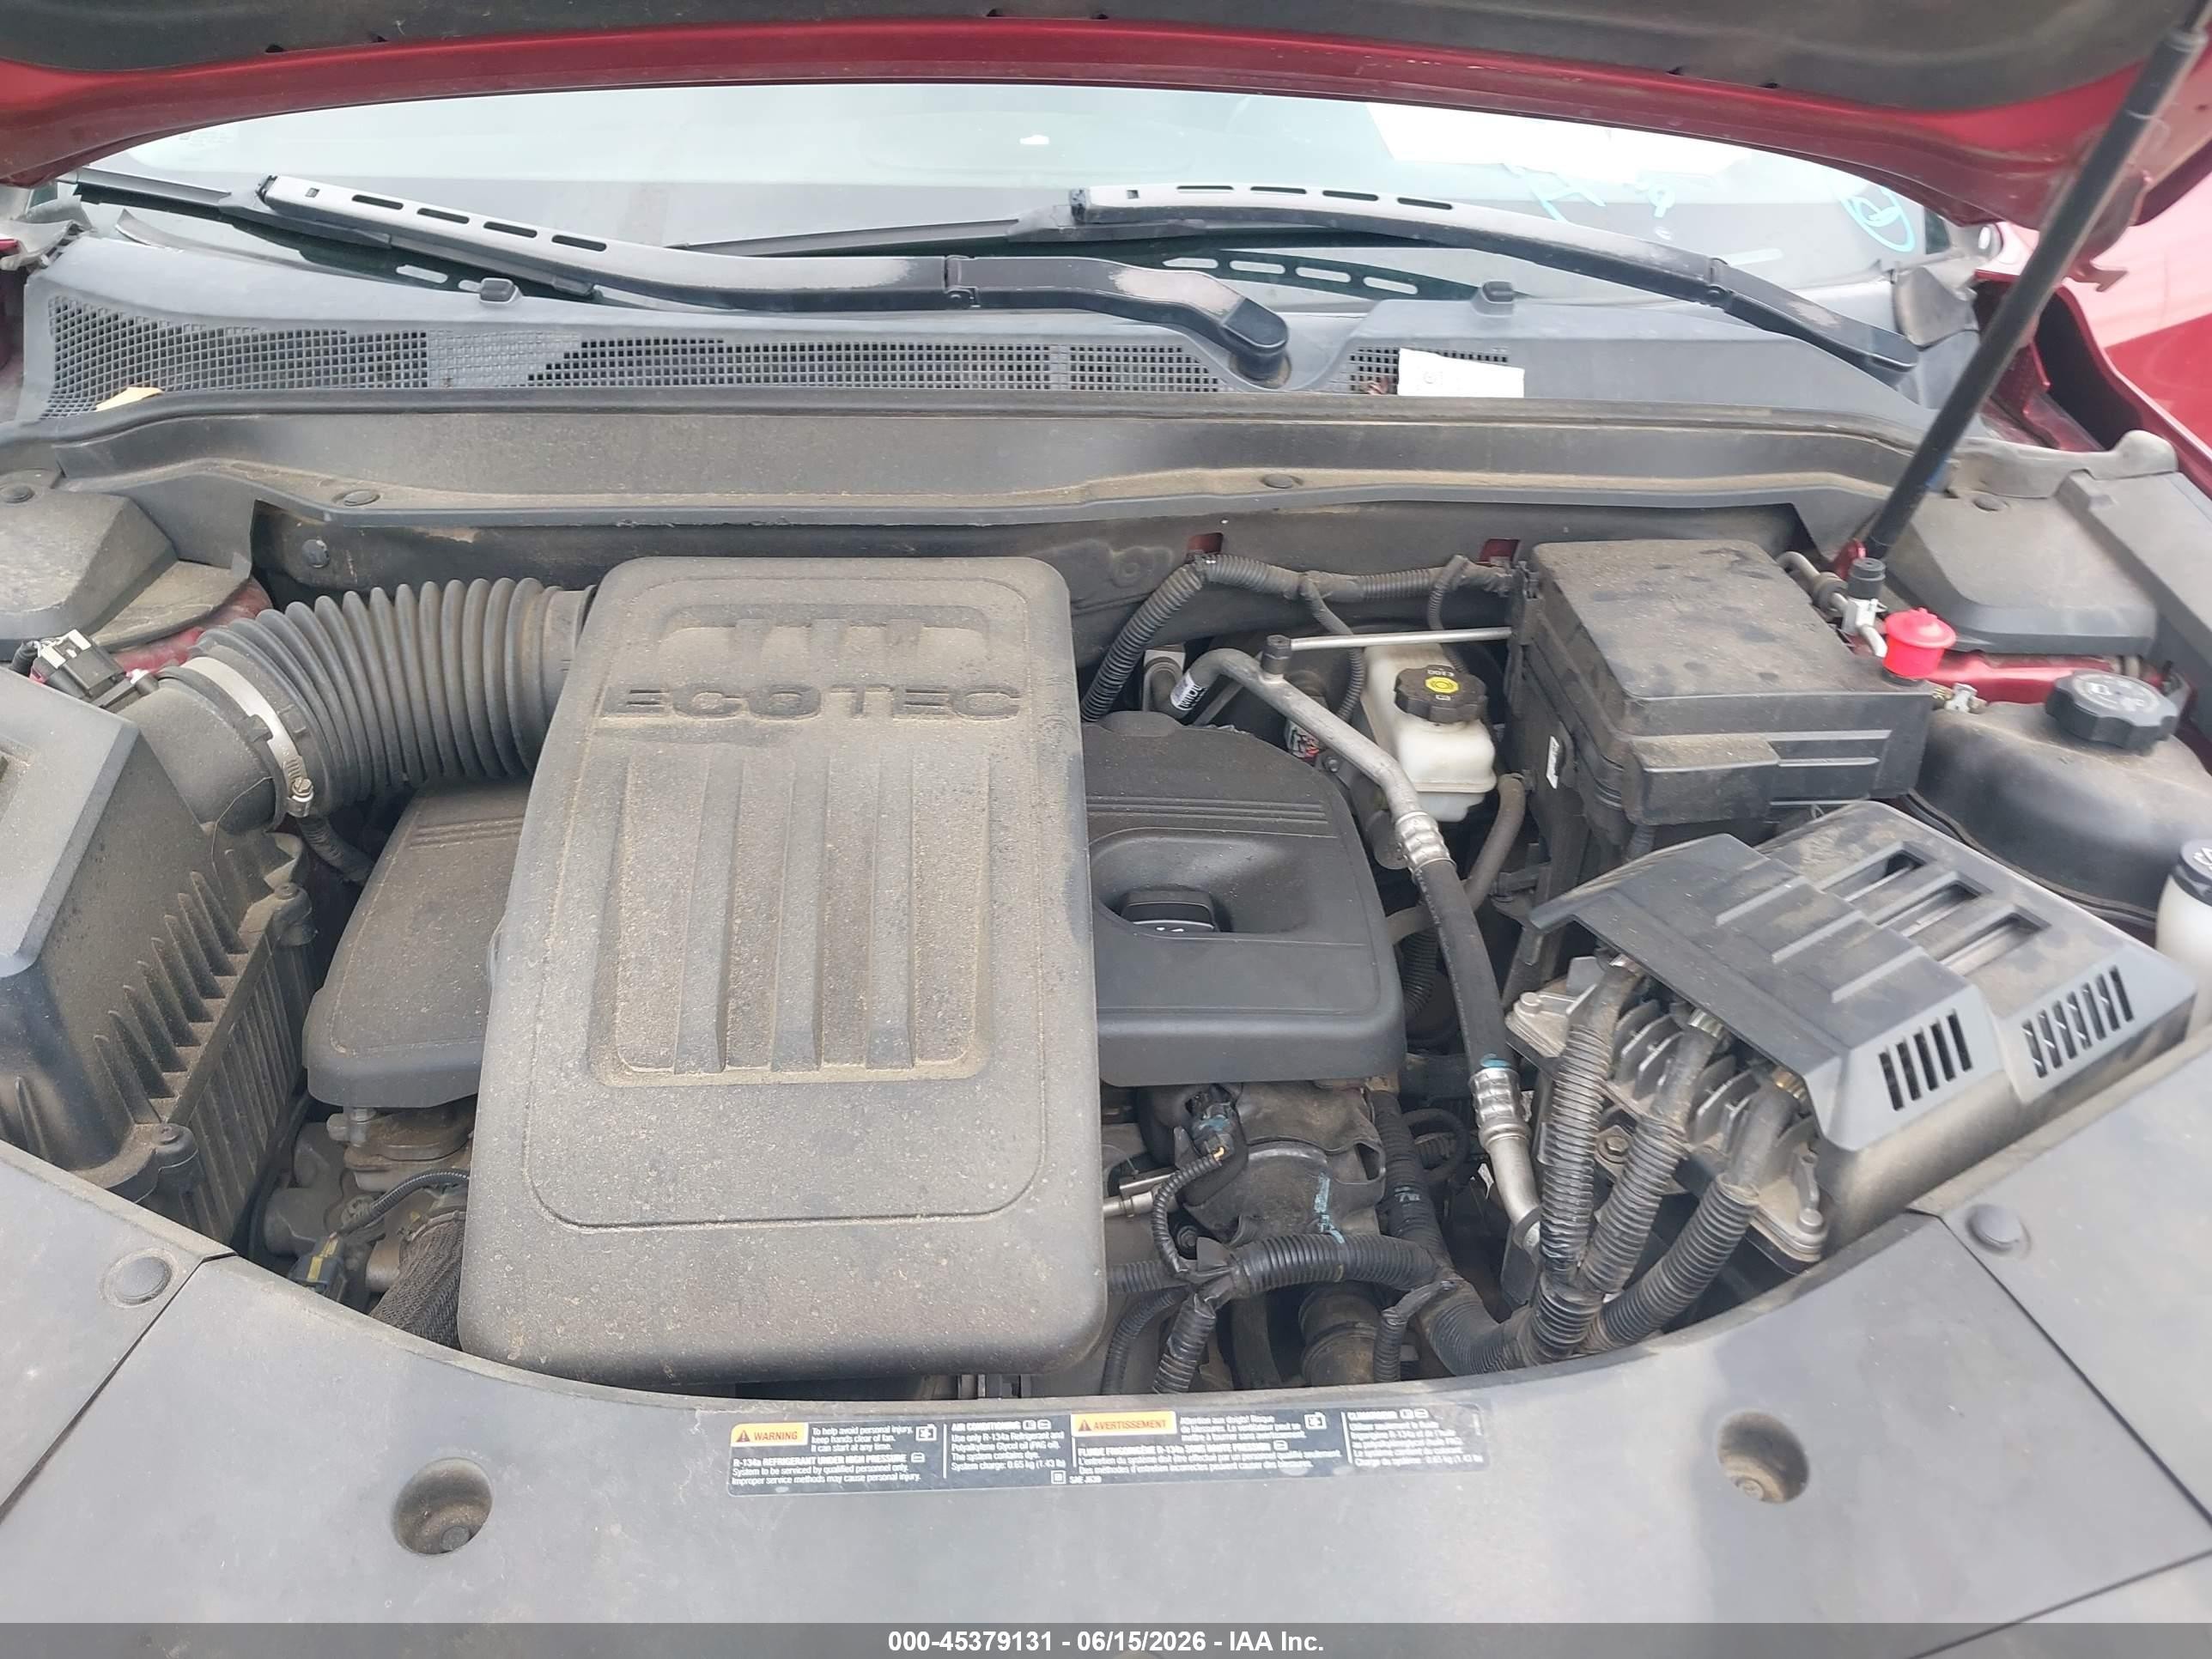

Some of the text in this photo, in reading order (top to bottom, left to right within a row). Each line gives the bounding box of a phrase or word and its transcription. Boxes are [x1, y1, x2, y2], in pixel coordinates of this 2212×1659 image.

[602, 686, 1020, 720] ECOTEC
[951, 1423, 966, 1431] AIR
[1094, 1419, 1166, 1430] AVERTISSEMENT
[754, 1431, 798, 1441] WARNING
[822, 1426, 837, 1436] help
[860, 1425, 890, 1435] personal
[811, 1436, 830, 1444] keep
[967, 1434, 981, 1443] only
[733, 1458, 763, 1467] R-134a
[763, 1456, 816, 1466] REFRIGERANT
[866, 1454, 907, 1463] PRESSURE
[732, 1467, 761, 1477] System
[761, 1467, 769, 1475] to
[769, 1466, 780, 1474] be
[781, 1465, 813, 1474] serviced
[814, 1465, 823, 1475] by
[823, 1464, 854, 1475] qualified
[855, 1463, 890, 1474] personnel
[951, 1462, 978, 1472] System
[732, 1476, 765, 1486] Improper
[766, 1475, 792, 1484] service
[793, 1474, 825, 1483] methods
[827, 1475, 843, 1484] may
[866, 1473, 899, 1483] personal
